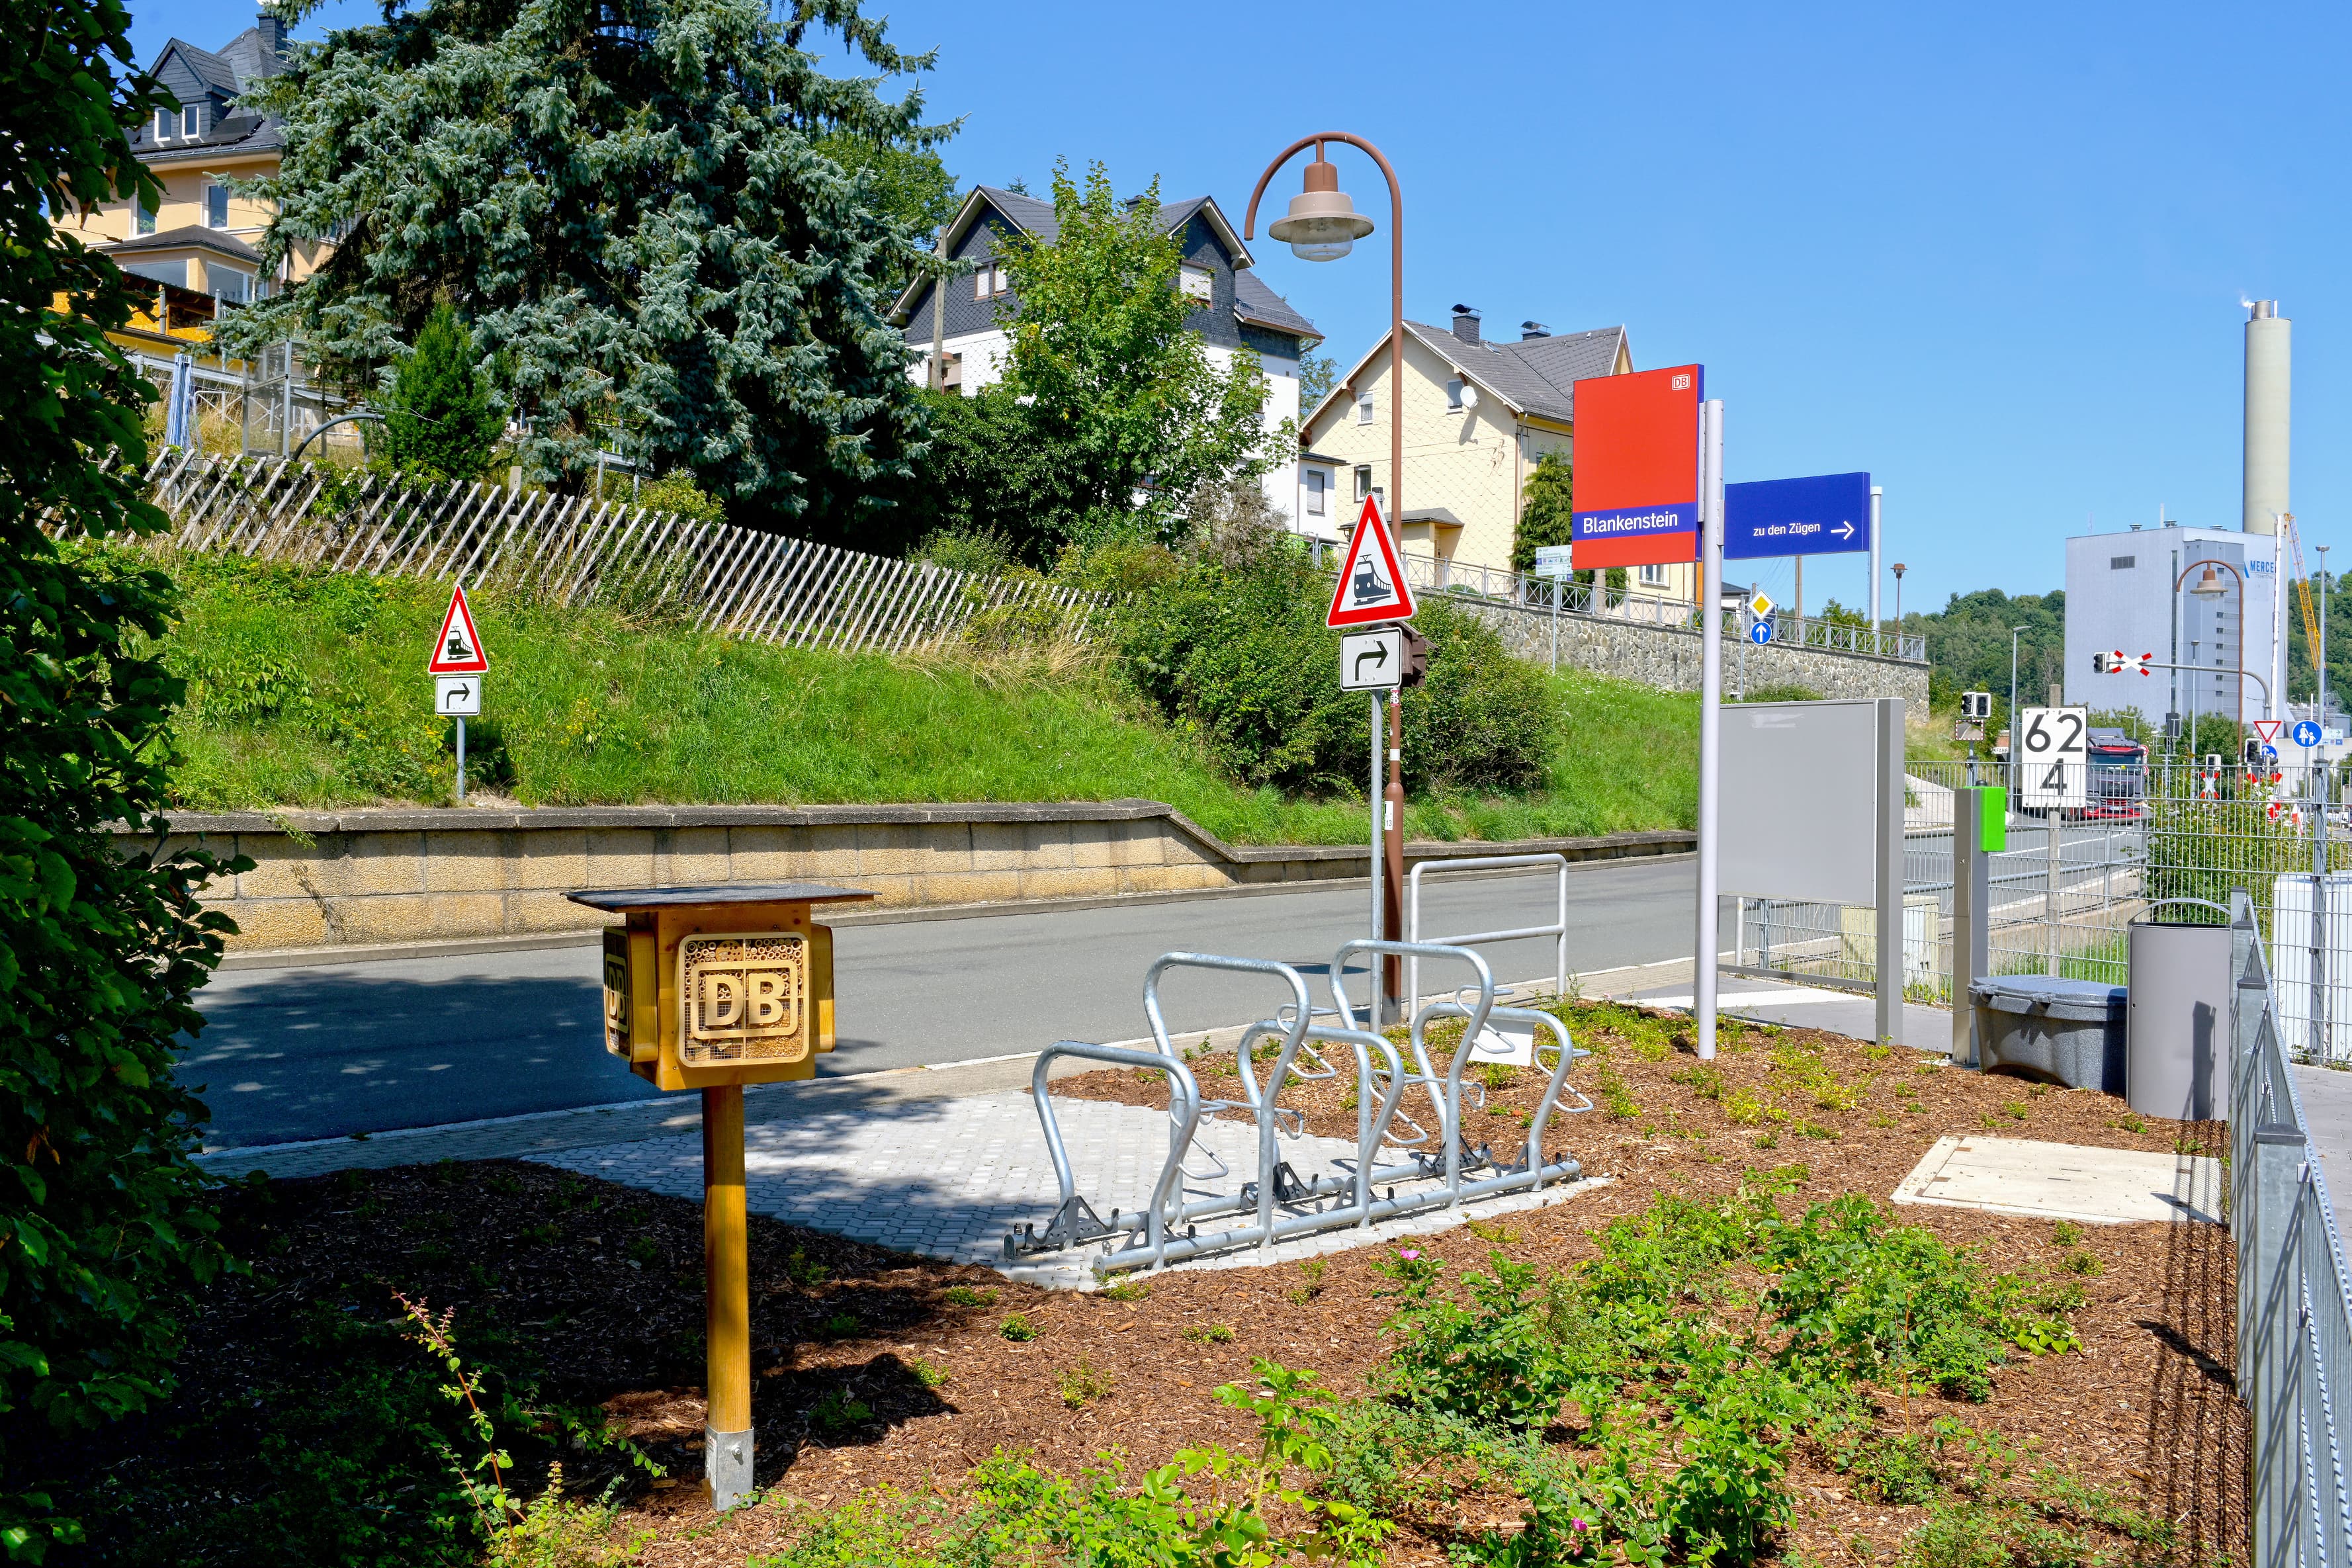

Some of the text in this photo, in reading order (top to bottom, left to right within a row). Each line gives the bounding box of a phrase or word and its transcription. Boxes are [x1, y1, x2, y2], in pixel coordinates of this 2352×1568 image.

[1674, 376, 1688, 388] DB
[1583, 511, 1678, 534] Blankenstein
[1753, 522, 1821, 537] zu den Zügen
[2250, 560, 2275, 573] MERCE
[2025, 713, 2083, 753] 62
[2039, 758, 2068, 796] 4
[608, 965, 626, 1020] DB
[705, 973, 785, 1026] DB
